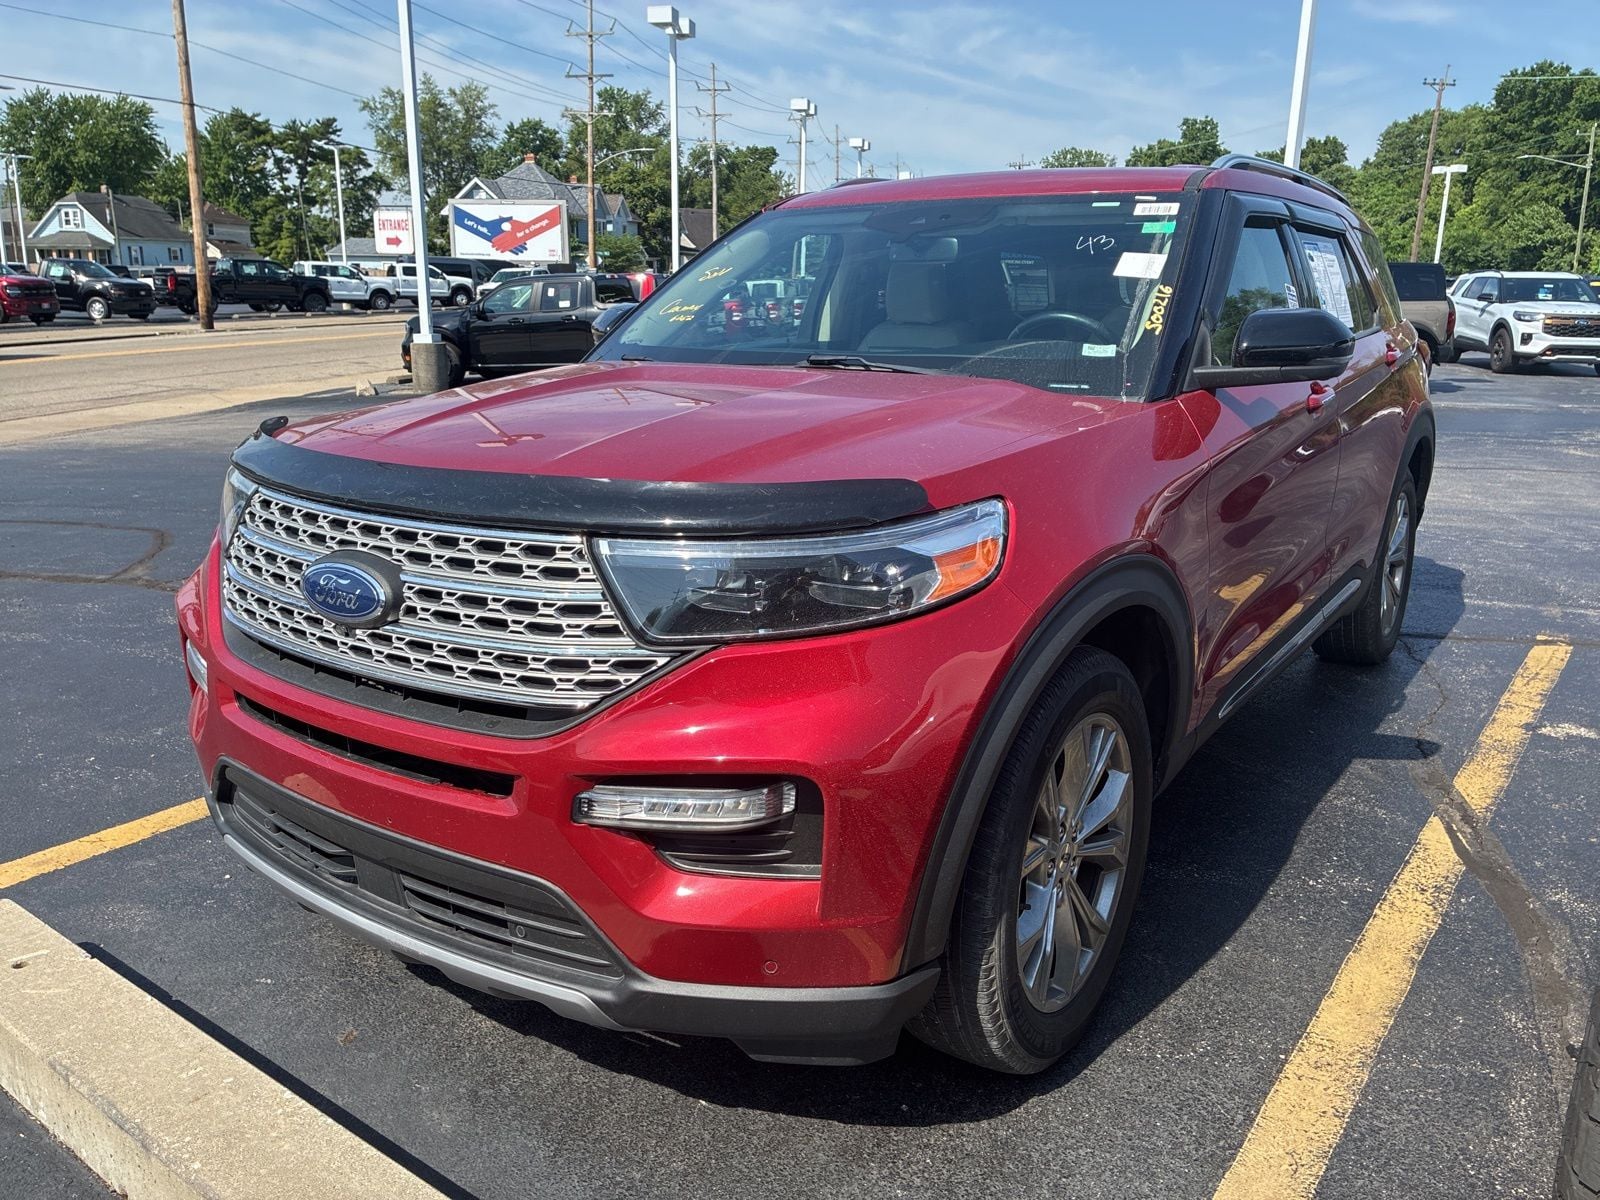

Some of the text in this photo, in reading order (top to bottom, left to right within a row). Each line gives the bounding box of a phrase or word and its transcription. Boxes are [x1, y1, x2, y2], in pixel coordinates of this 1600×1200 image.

[378, 218, 409, 231] ENTRANCE
[463, 218, 478, 229] Let's
[516, 231, 525, 239] for
[1075, 234, 1115, 255] 43
[314, 573, 361, 610] Ford
